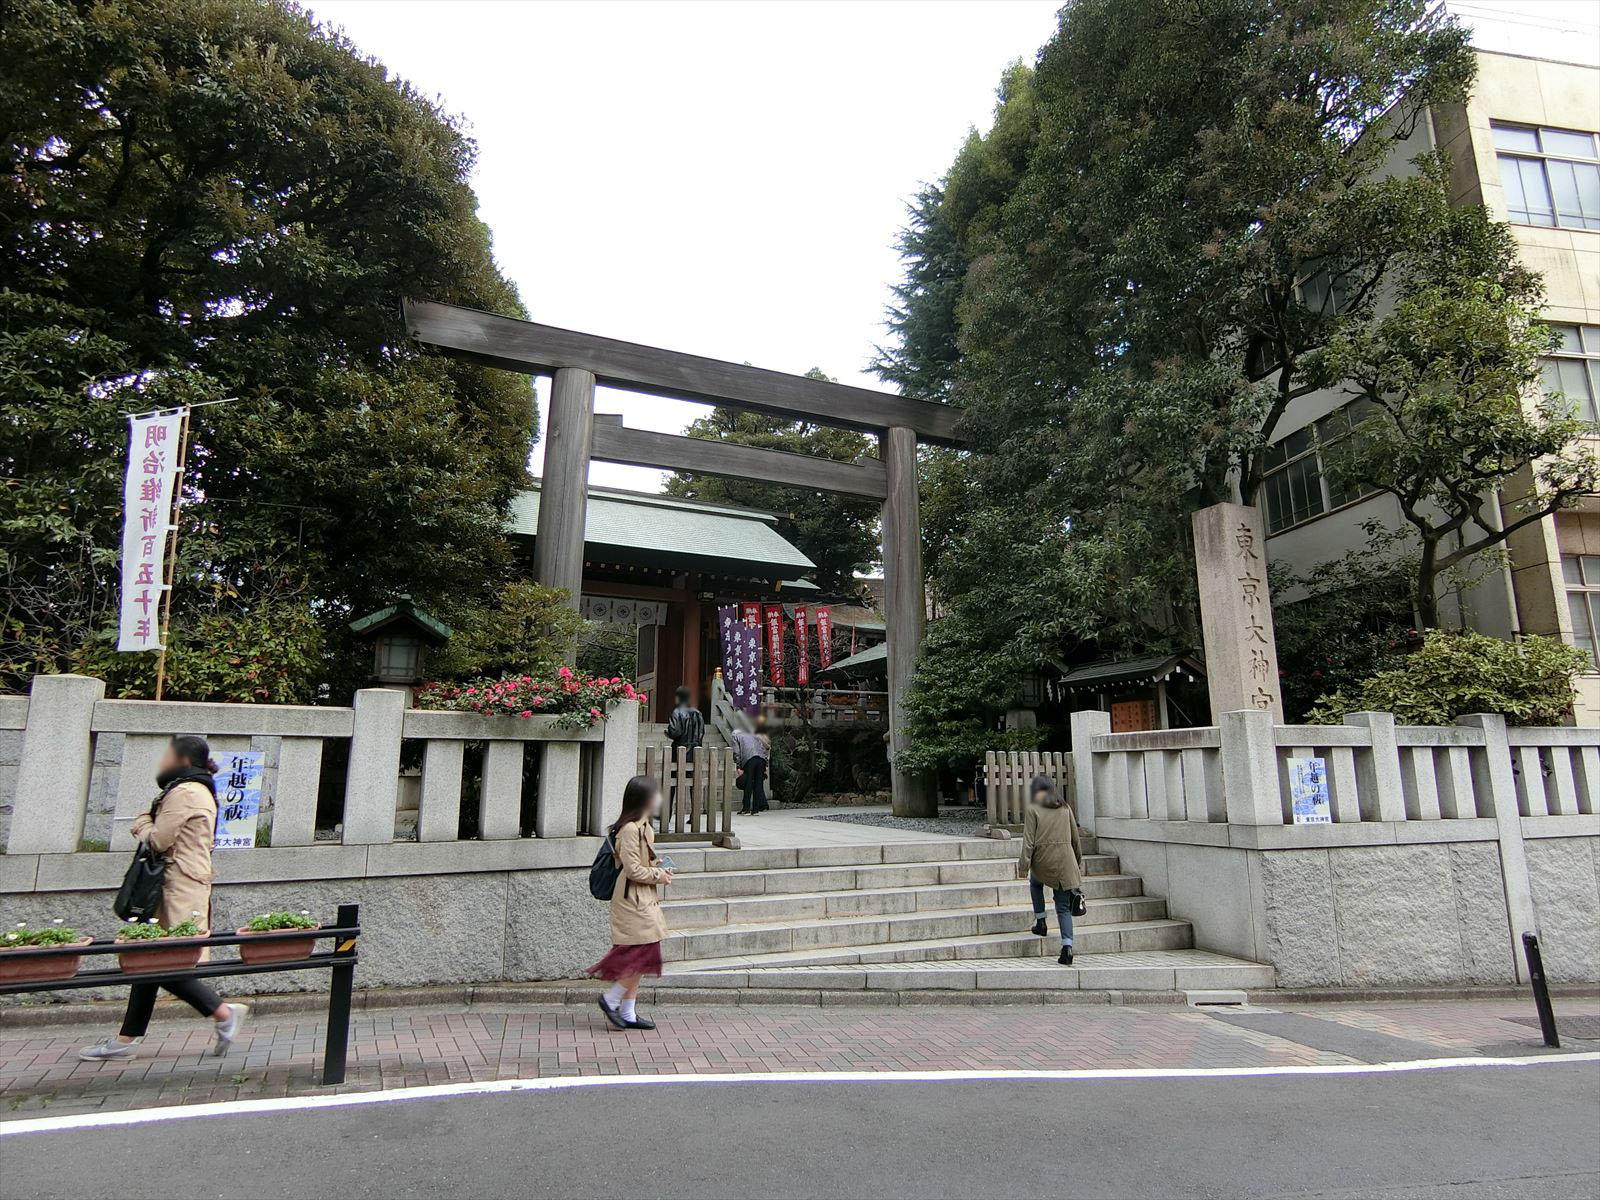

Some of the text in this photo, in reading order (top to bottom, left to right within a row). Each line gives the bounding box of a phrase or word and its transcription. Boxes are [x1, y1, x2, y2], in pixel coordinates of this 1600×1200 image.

[1235, 522, 1274, 710] 東京大神宮
[748, 637, 758, 705] 東京大神宮
[223, 756, 247, 821] 年越の祓
